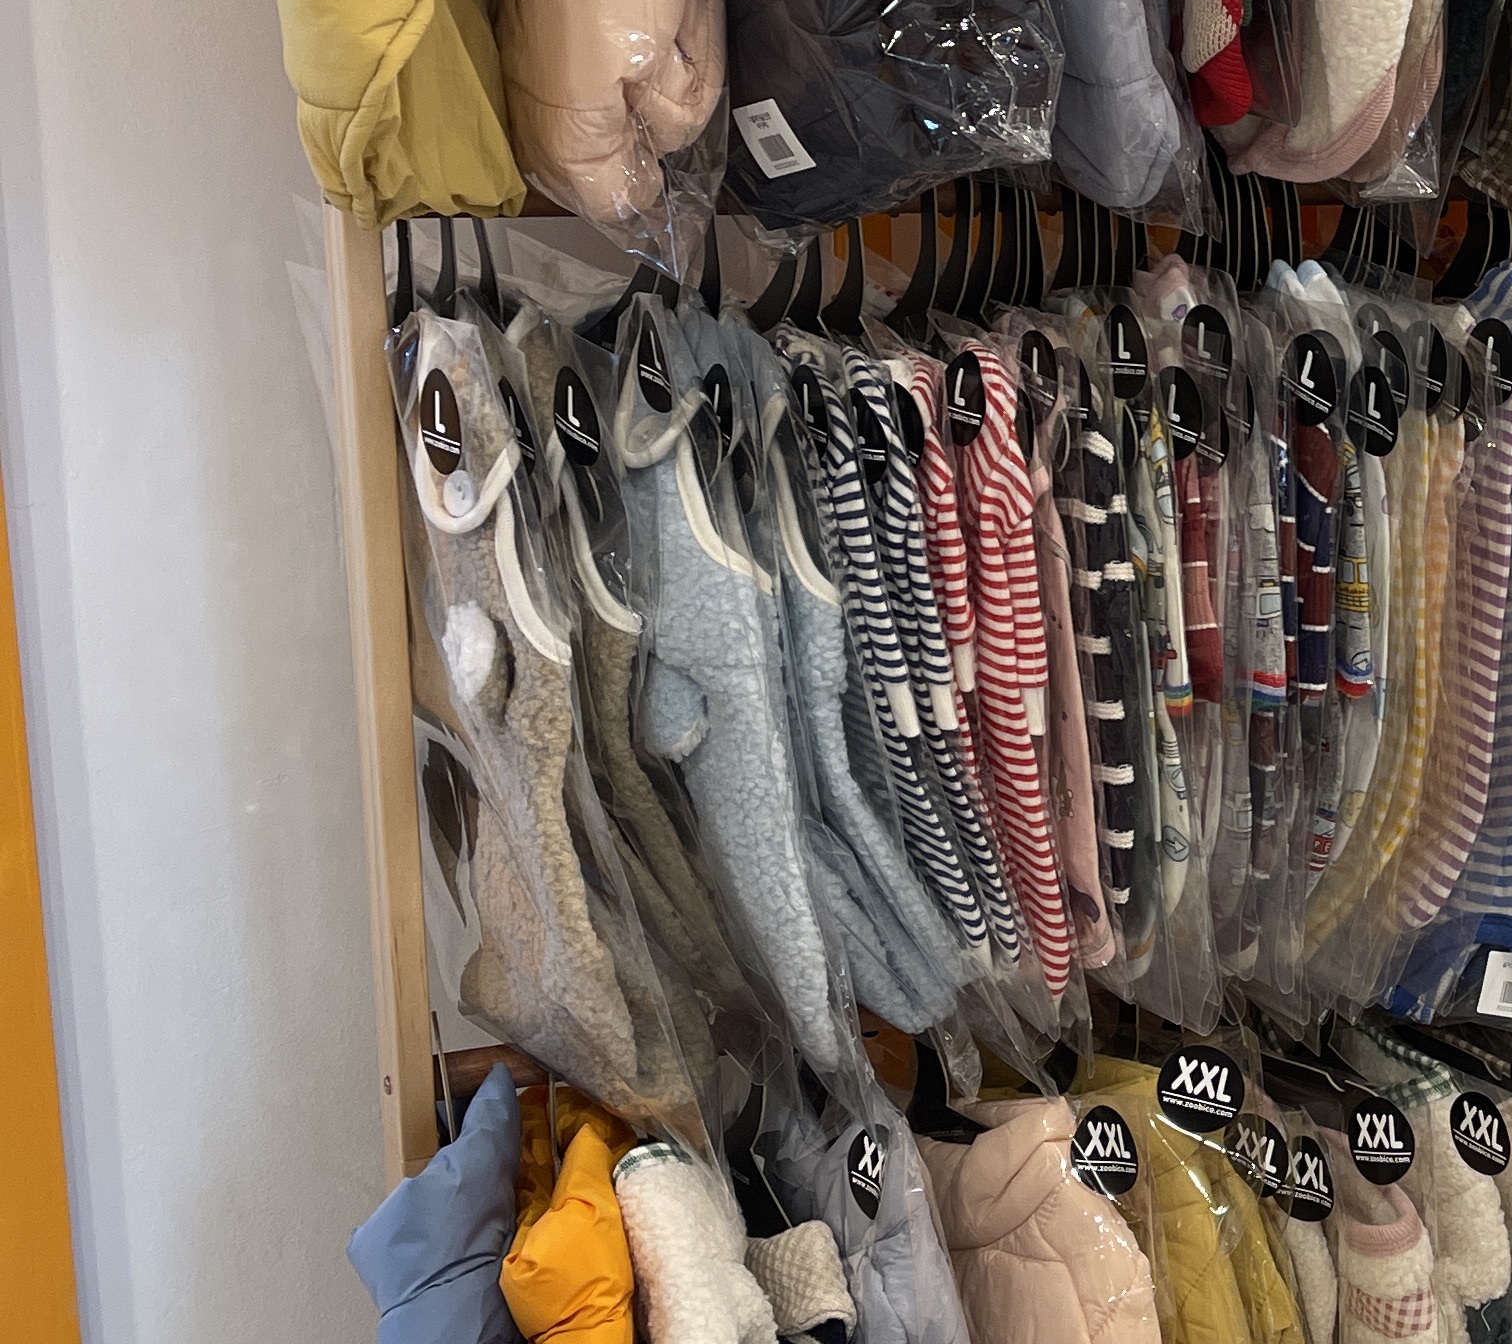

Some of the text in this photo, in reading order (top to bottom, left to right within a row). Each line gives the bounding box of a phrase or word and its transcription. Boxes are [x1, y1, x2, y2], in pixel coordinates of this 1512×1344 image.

[1118, 321, 1133, 358] L
[955, 366, 967, 407] L
[1302, 350, 1316, 388] L
[433, 389, 446, 435] L
[566, 385, 582, 428] L
[1169, 384, 1184, 423] L
[1367, 382, 1384, 420] L
[1170, 1055, 1233, 1104] XXL
[1162, 1094, 1234, 1119] www.zoobico.com
[1086, 1120, 1132, 1159] XXL
[1356, 1112, 1404, 1150] XXL
[1459, 1100, 1504, 1153] XXL
